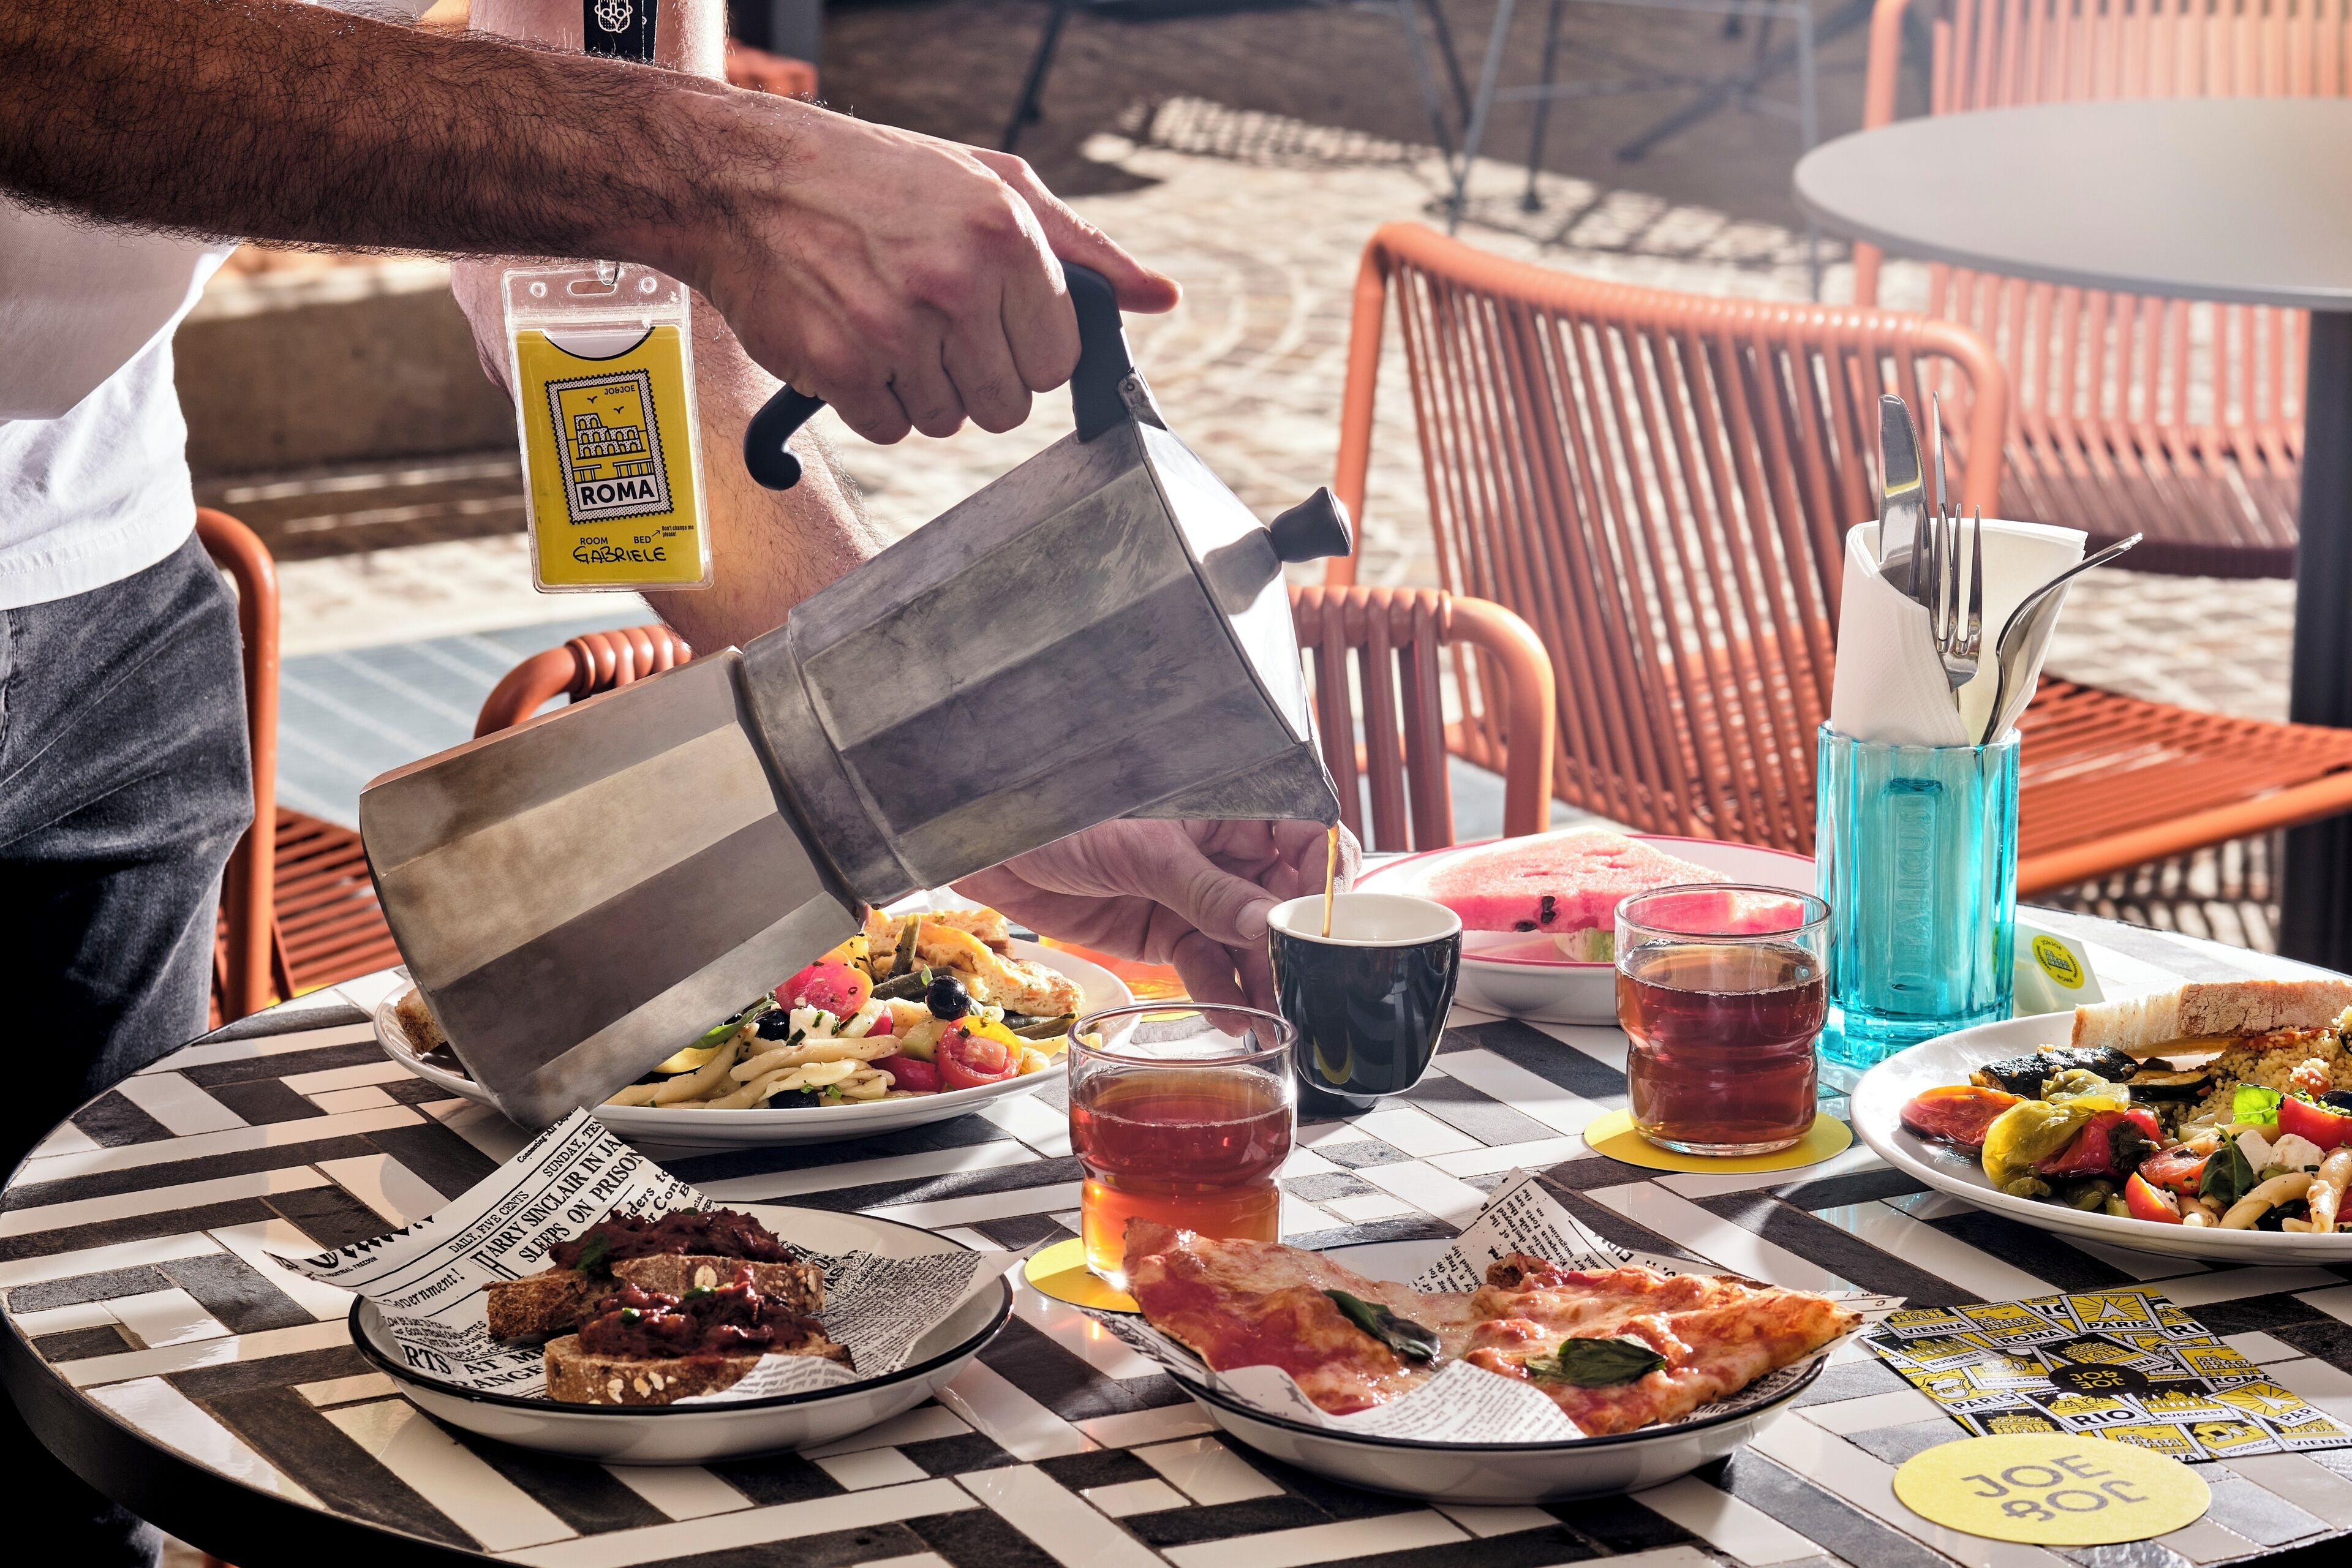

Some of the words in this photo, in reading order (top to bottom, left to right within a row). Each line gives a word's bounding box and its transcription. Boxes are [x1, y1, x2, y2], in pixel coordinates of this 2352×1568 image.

[604, 385, 636, 395] JO&JOE
[580, 479, 655, 505] ROMA
[573, 546, 666, 564] GABRIELE
[543, 1138, 587, 1177] SUNDAY,
[521, 1170, 589, 1227] SINCLAIR
[579, 1152, 606, 1175] IN
[596, 1133, 624, 1158] JA
[1521, 1188, 1533, 1202] the
[519, 1222, 570, 1264] SLEEPS
[567, 1199, 595, 1224] ON
[589, 1148, 643, 1203] PRISON
[1506, 1200, 1520, 1216] this
[1536, 1207, 1545, 1217] on
[448, 1232, 482, 1253] DAILY,
[476, 1214, 502, 1235] FIVE
[499, 1191, 529, 1215] CENTS
[1489, 1213, 1501, 1227] the
[1499, 1207, 1528, 1243] destroyed
[1518, 1216, 1532, 1234] side
[1527, 1208, 1541, 1229] forts
[1541, 1230, 1568, 1267] European
[1548, 1222, 1574, 1259] magazine
[1902, 1321, 1970, 1335] VIENNA
[2086, 1320, 2152, 1329] PARIS
[1999, 1330, 2063, 1346] ROMA
[464, 1357, 502, 1375] AT
[1929, 1351, 1983, 1366] BUDAPEST
[2069, 1370, 2119, 1381] JO&
[2080, 1378, 2127, 1389] JOE
[1952, 1393, 2019, 1410] PARIS
[2071, 1410, 2136, 1427] RIO
[2158, 1410, 2225, 1419] BUDAPEST
[2226, 1441, 2275, 1453] HOSSEGO
[1961, 1454, 2113, 1498] JOE
[2000, 1479, 2150, 1521] JO&
